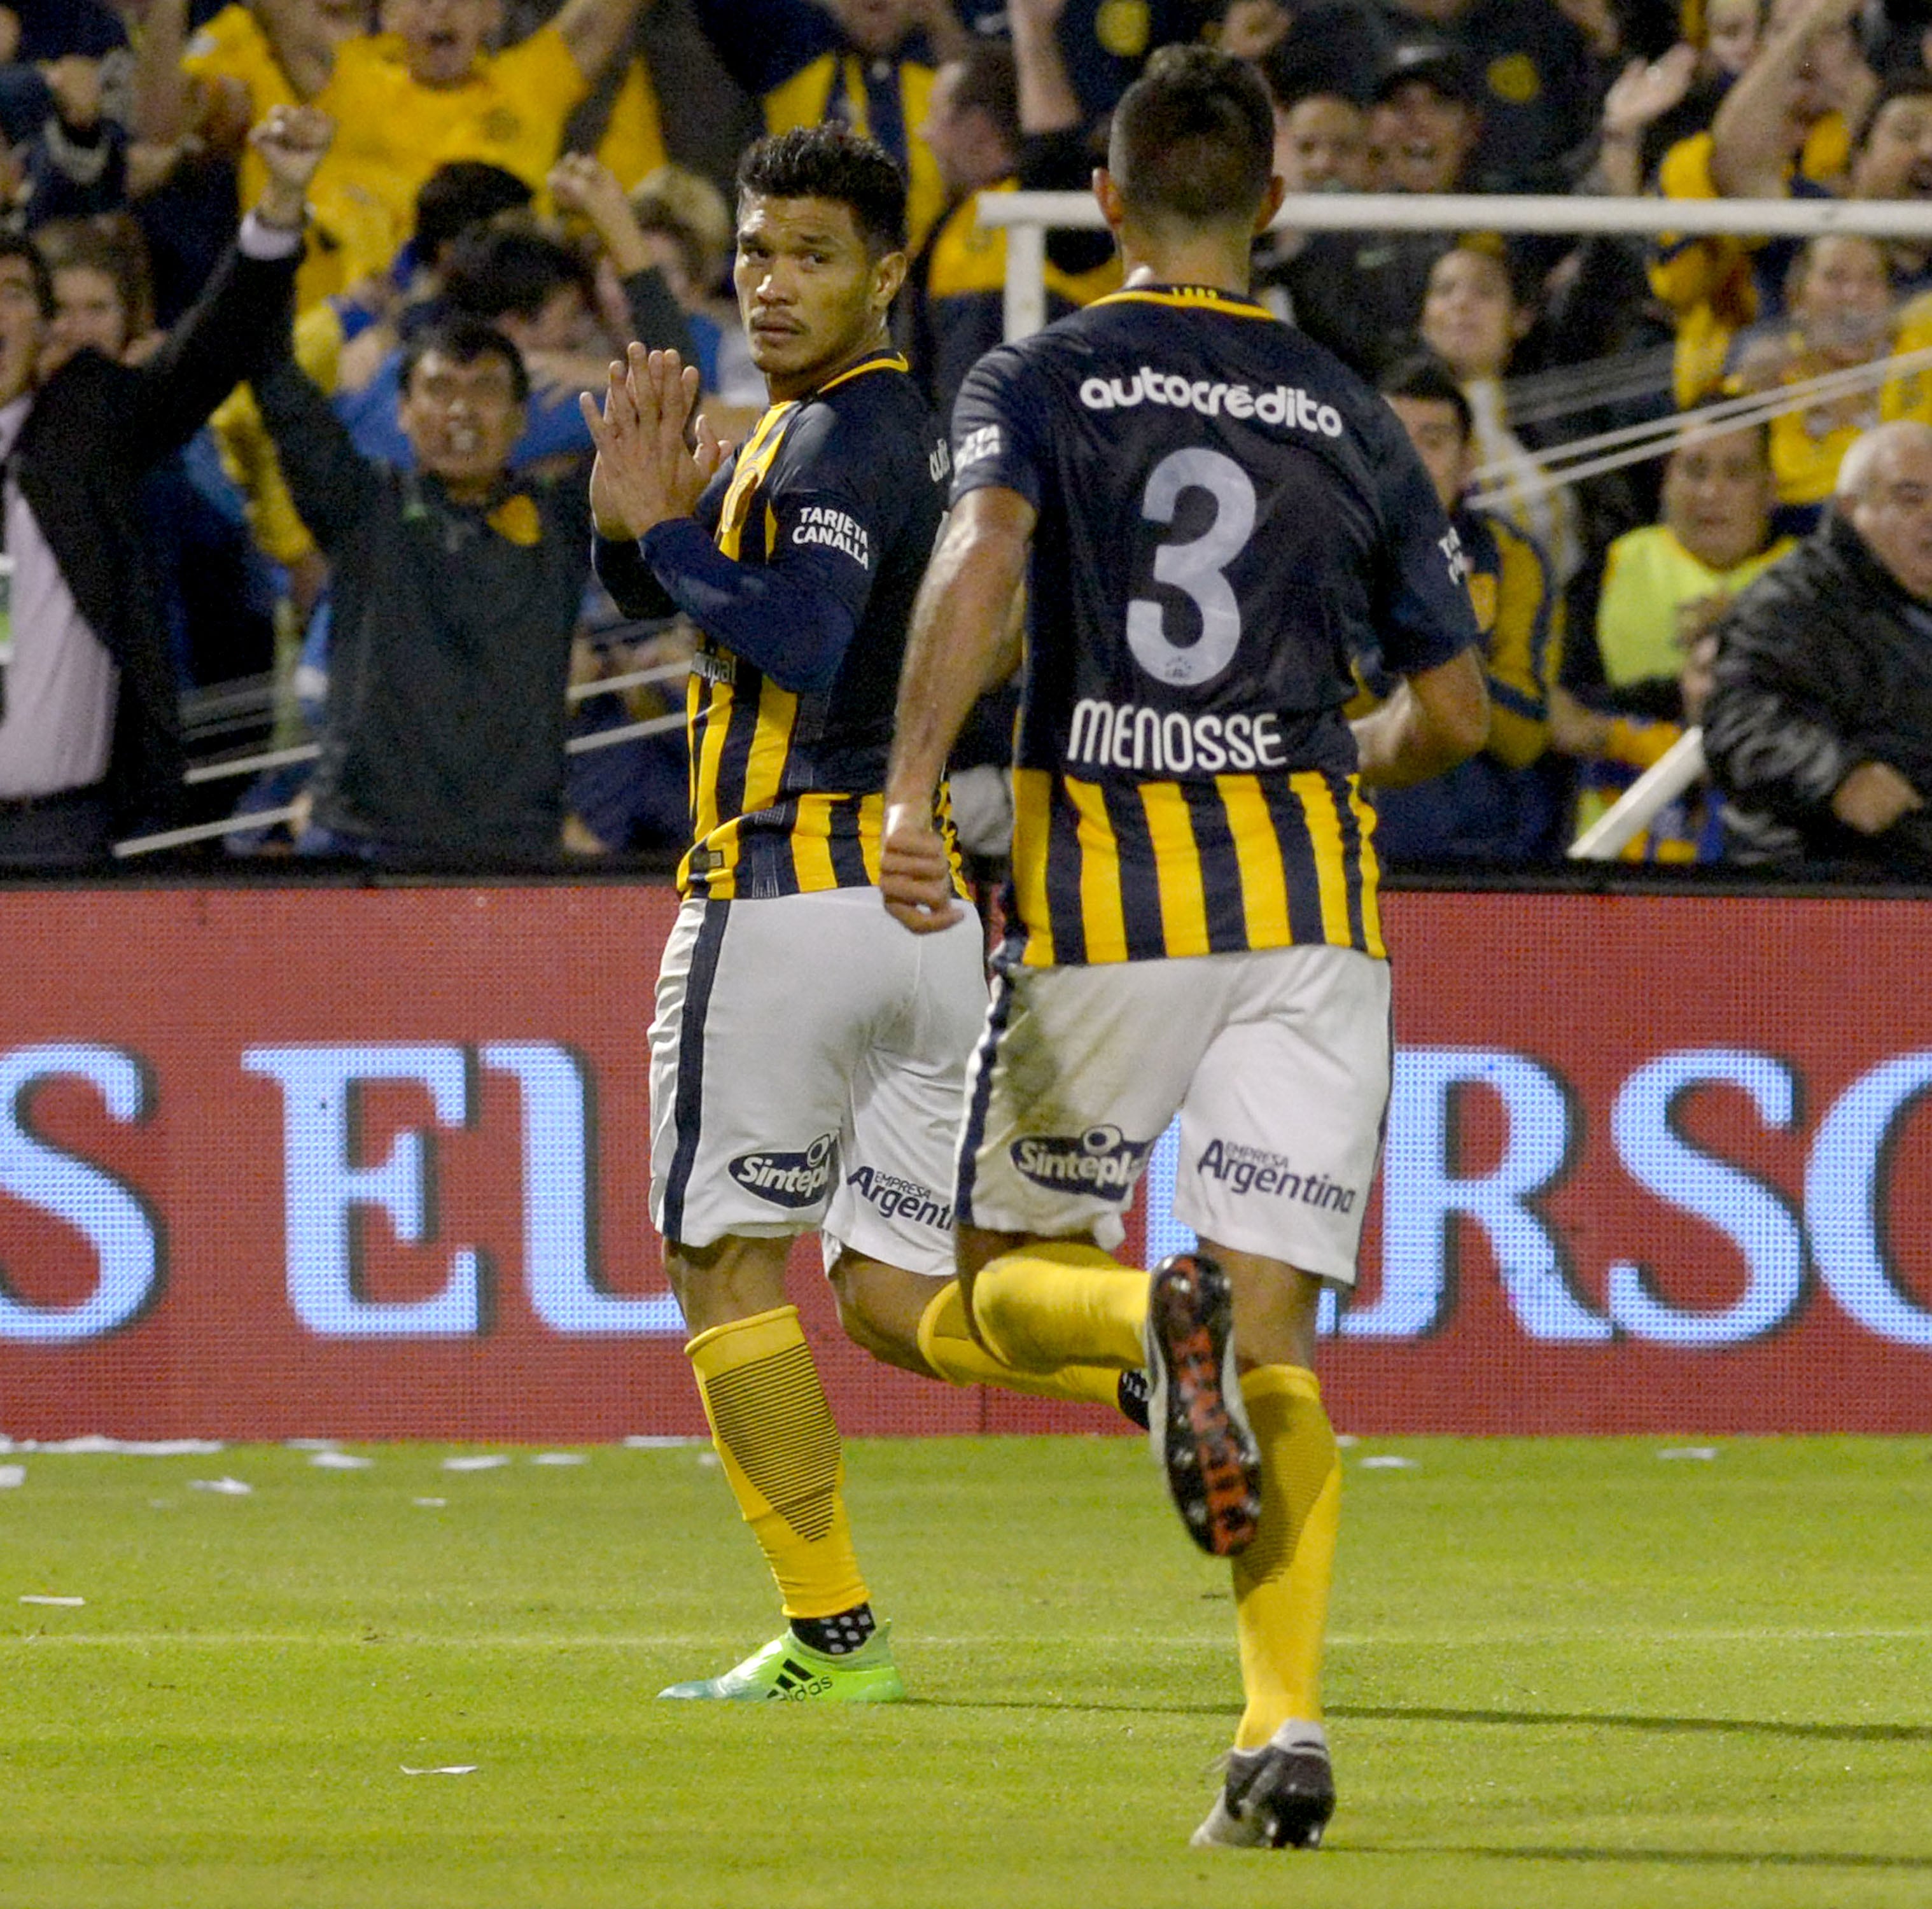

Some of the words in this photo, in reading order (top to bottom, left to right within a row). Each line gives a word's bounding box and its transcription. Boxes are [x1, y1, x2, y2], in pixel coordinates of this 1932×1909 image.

[1080, 366, 1342, 437] autocrédito
[792, 526, 869, 571] CANALLA
[800, 507, 868, 549] TARJETA
[1126, 448, 1256, 686] 3
[1067, 697, 1287, 773] MENOSSE
[875, 1170, 931, 1199] EMPRESA
[1197, 1138, 1356, 1213] Argentina
